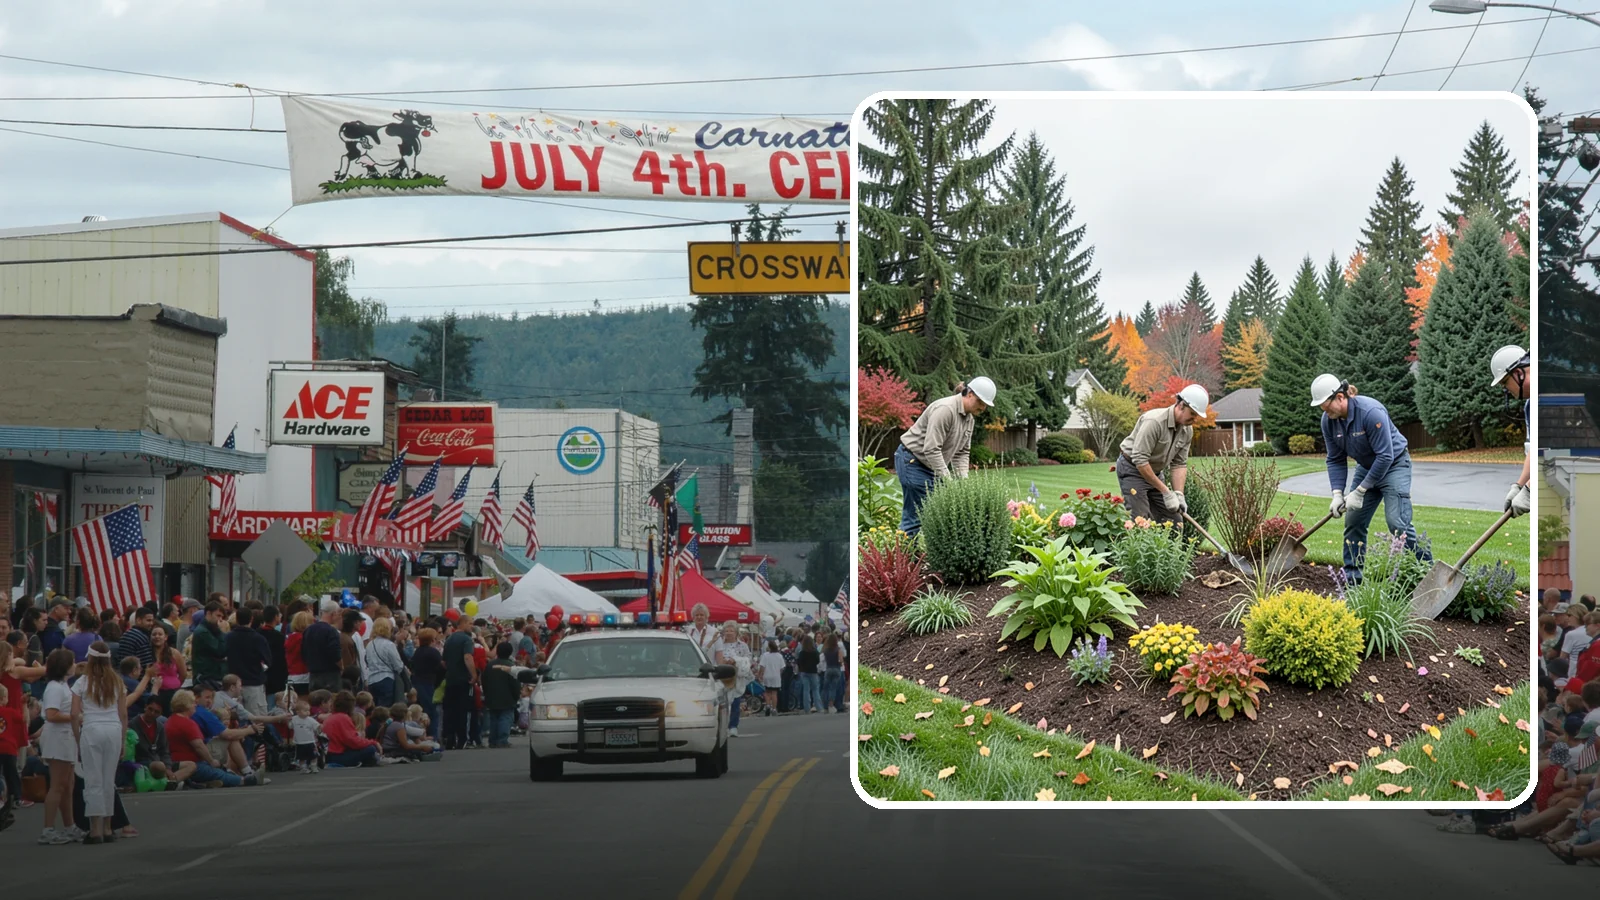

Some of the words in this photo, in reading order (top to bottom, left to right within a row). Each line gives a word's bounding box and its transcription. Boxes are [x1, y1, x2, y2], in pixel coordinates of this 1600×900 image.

[694, 121, 850, 150] Carnat
[481, 140, 605, 193] JULY
[632, 150, 746, 197] 4th.
[697, 253, 850, 280] CROSSWA
[283, 380, 373, 420] ACE
[405, 408, 452, 422] CEDAR
[283, 420, 370, 436] Hardware
[416, 428, 476, 447] Coca-Cola
[353, 466, 385, 480] Simpl
[83, 484, 94, 495] St.
[95, 484, 124, 495] Vincent
[126, 485, 136, 495] de
[137, 485, 155, 496] Paul
[688, 526, 741, 535] CRNATION
[699, 535, 730, 543] GLASS
